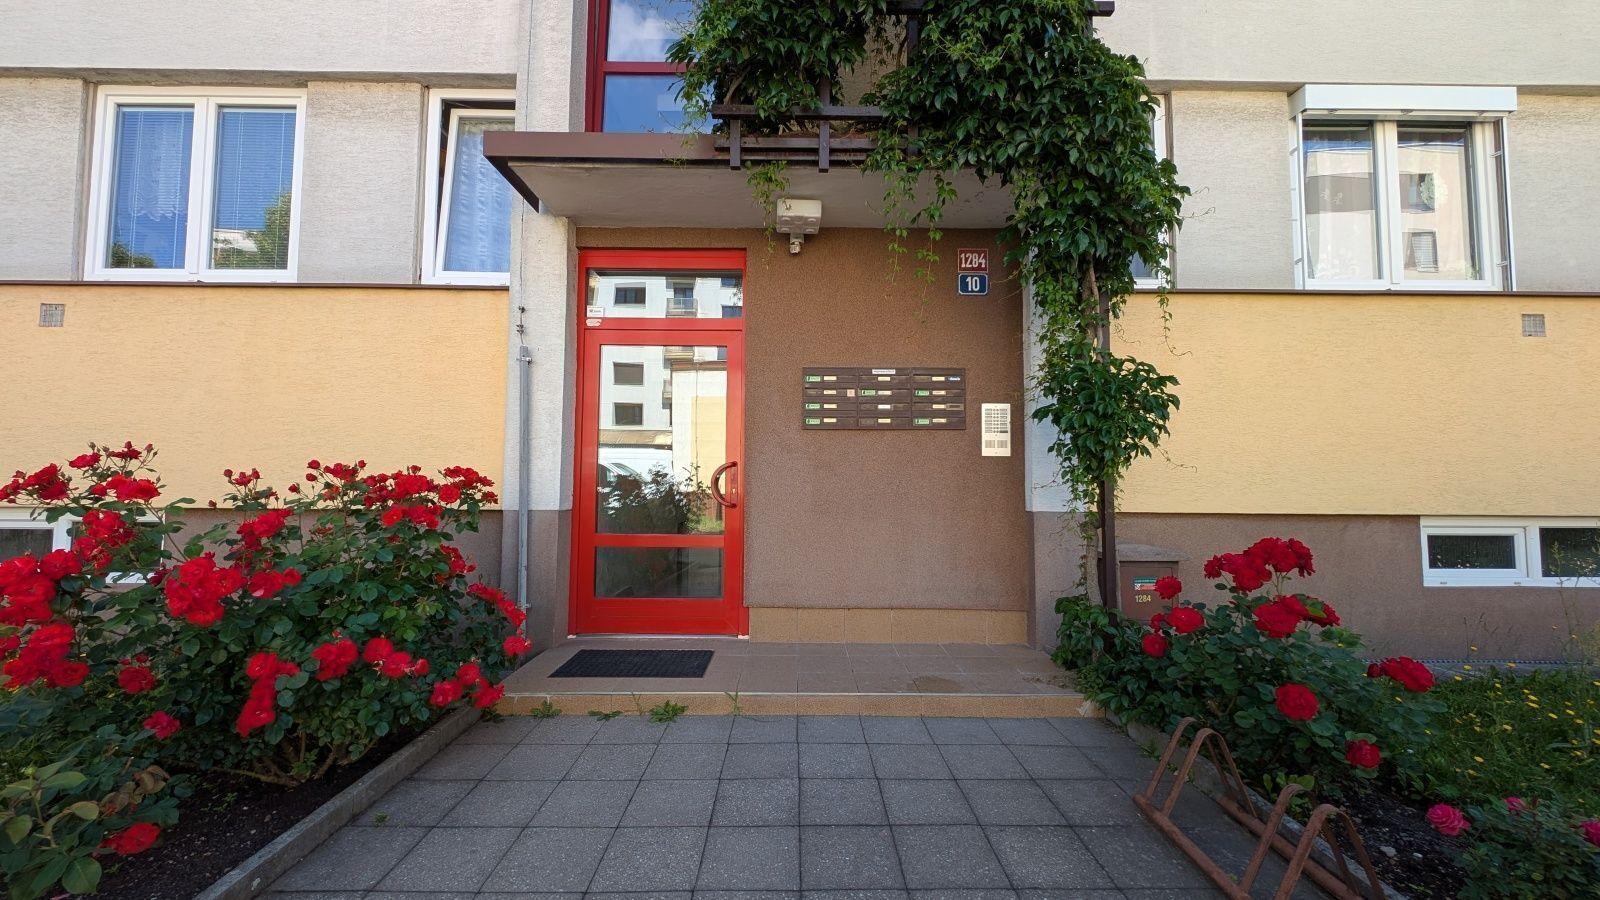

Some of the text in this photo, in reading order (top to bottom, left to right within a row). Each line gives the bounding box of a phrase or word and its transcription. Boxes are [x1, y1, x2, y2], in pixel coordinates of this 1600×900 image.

[960, 253, 986, 268] 1284
[965, 276, 980, 291] 10
[1135, 594, 1151, 602] 1284
